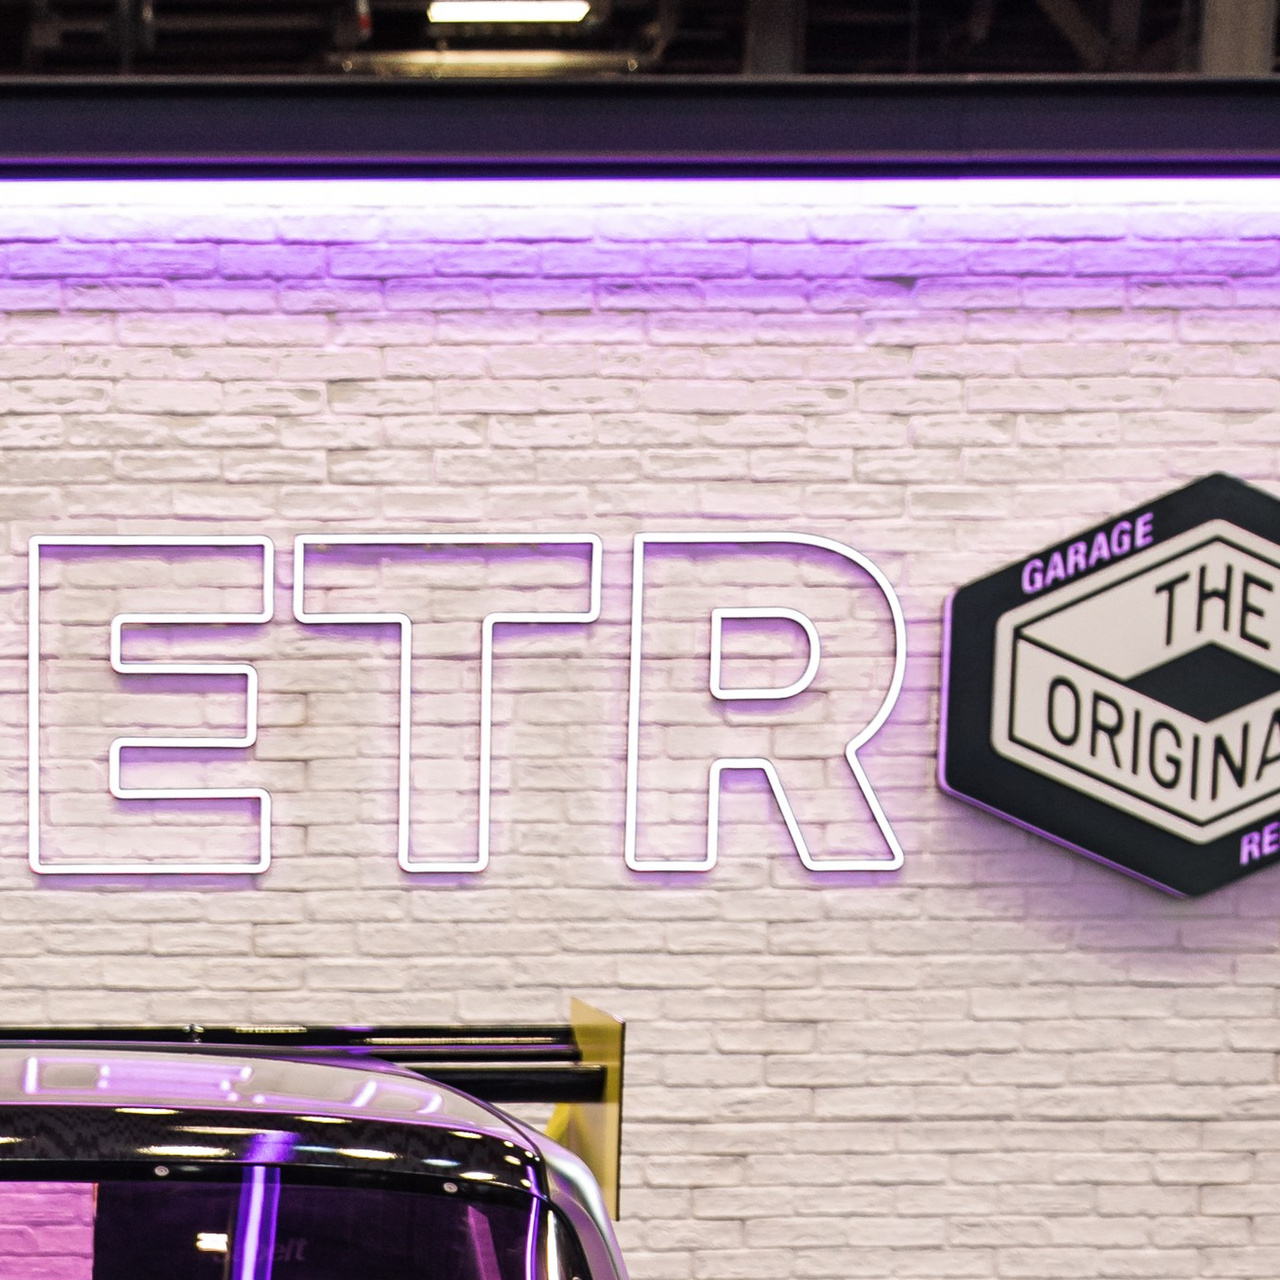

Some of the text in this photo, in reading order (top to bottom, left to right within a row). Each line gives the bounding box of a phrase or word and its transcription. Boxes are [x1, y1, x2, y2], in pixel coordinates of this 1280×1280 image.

[1021, 512, 1154, 594] GARAGE
[1155, 563, 1274, 651] THE
[1240, 821, 1280, 866] RE
